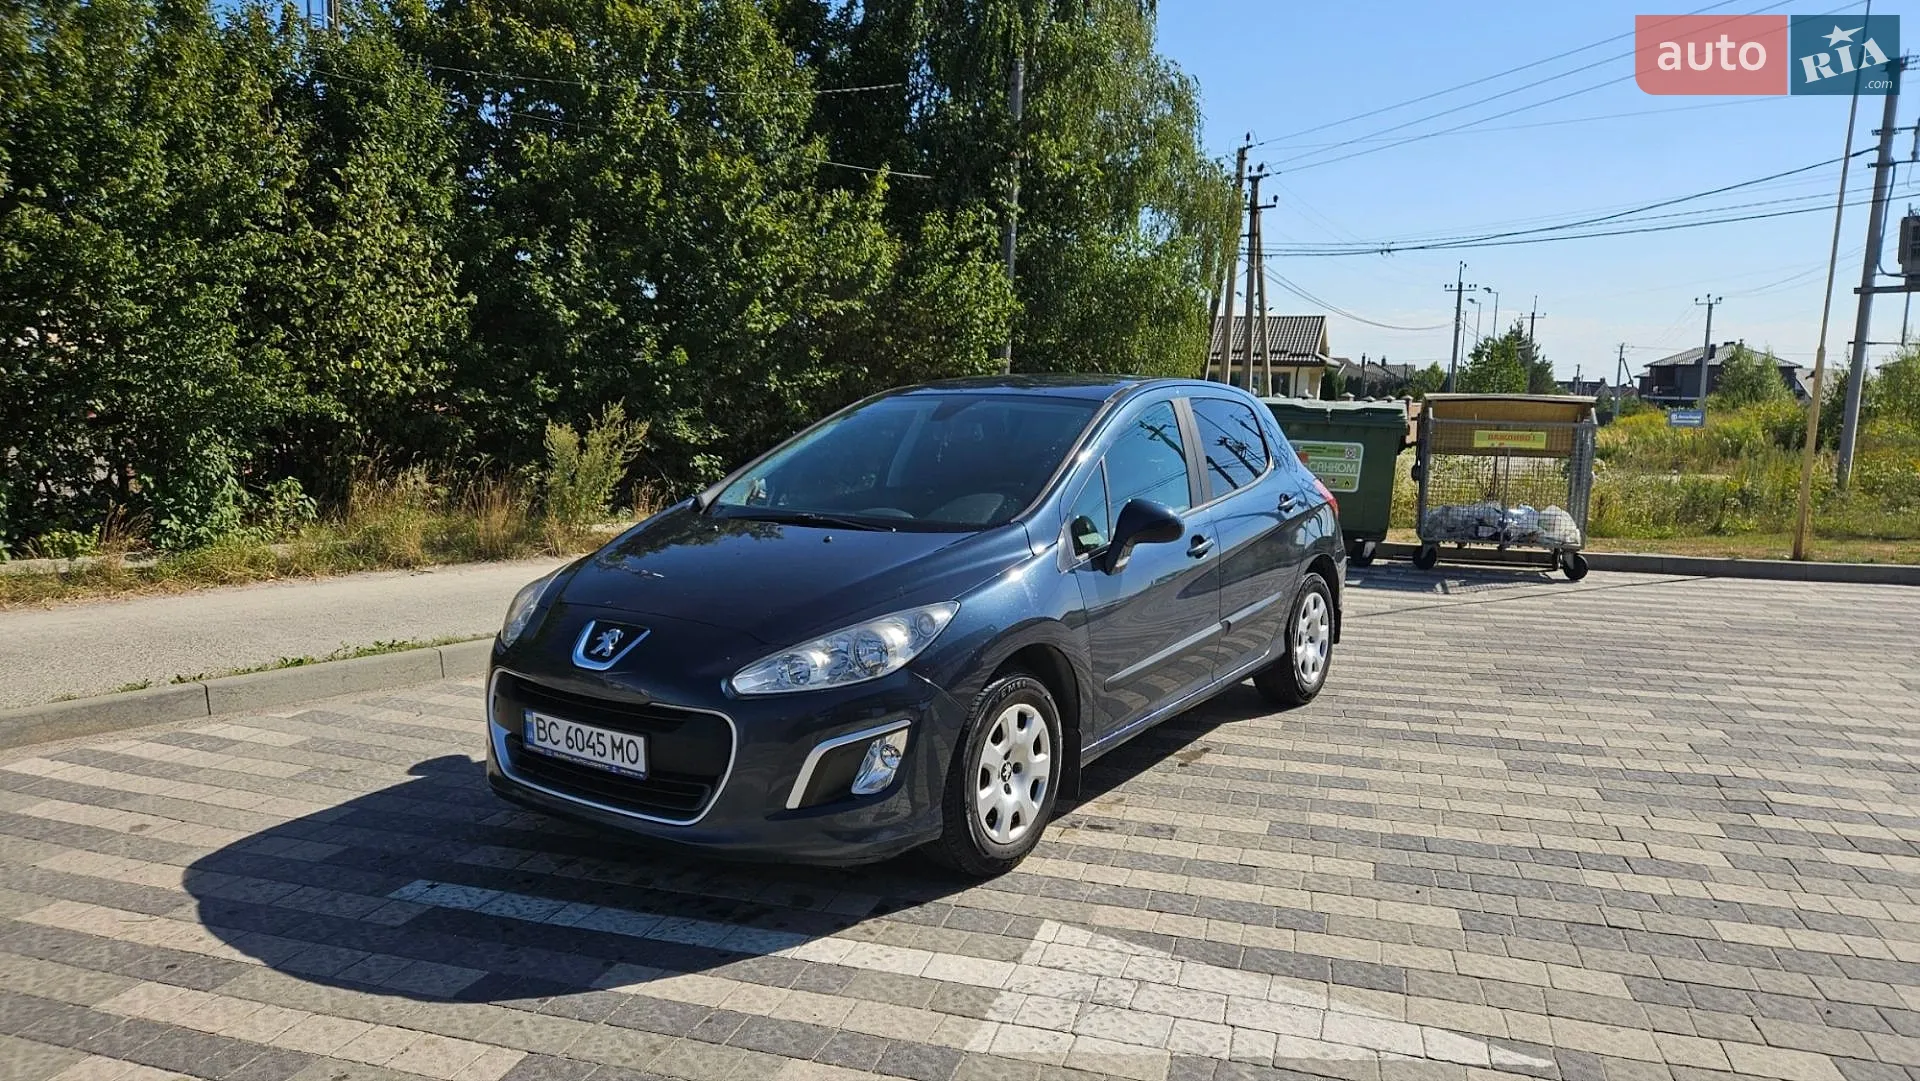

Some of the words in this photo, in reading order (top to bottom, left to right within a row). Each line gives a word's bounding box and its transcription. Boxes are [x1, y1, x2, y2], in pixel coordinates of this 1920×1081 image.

[535, 716, 560, 746] BC
[565, 725, 607, 758] 6045
[610, 734, 640, 765] MO
